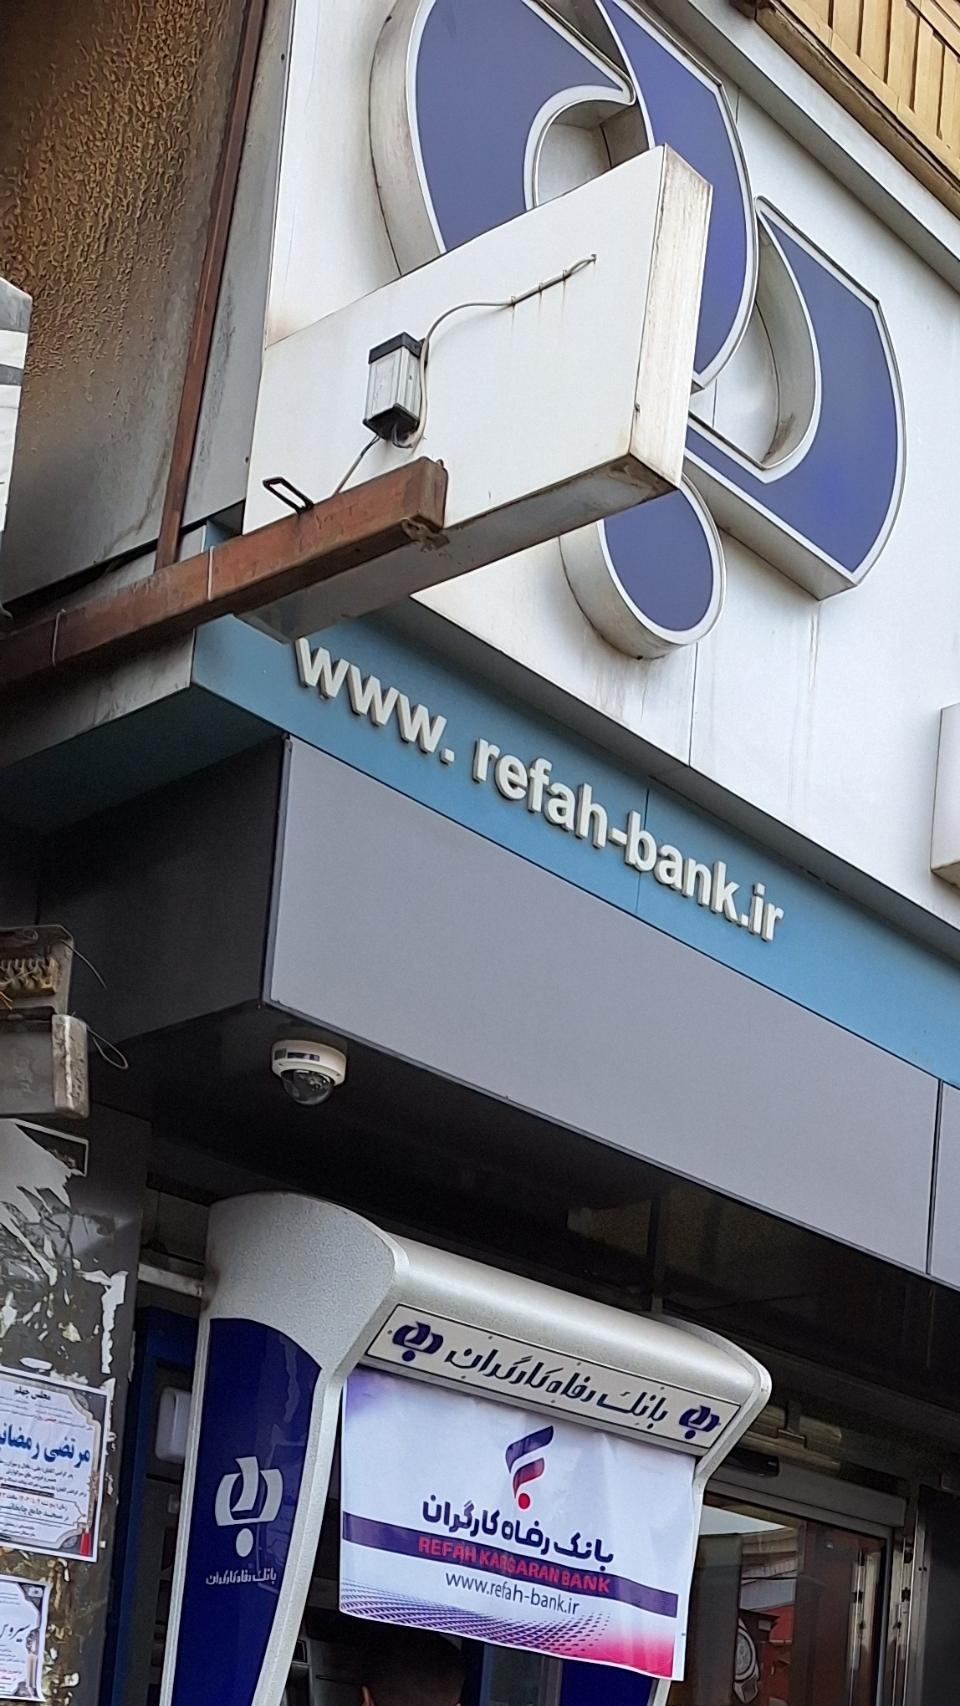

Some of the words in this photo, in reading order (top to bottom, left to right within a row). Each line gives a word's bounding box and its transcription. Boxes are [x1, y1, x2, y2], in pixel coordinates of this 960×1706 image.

[445, 1348, 564, 1389] کارگران
[545, 1372, 597, 1402] رفاه
[596, 1391, 668, 1429] بانک
[44, 1436, 91, 1468] مرتضی
[422, 1495, 500, 1537] کارگران
[501, 1520, 551, 1555] رفاه
[553, 1532, 614, 1572] بانک
[418, 1536, 477, 1563] REFAH
[479, 1549, 560, 1582] KARGARAN
[561, 1570, 610, 1593] BANK
[445, 1573, 581, 1615] www.refah-bank.ir
